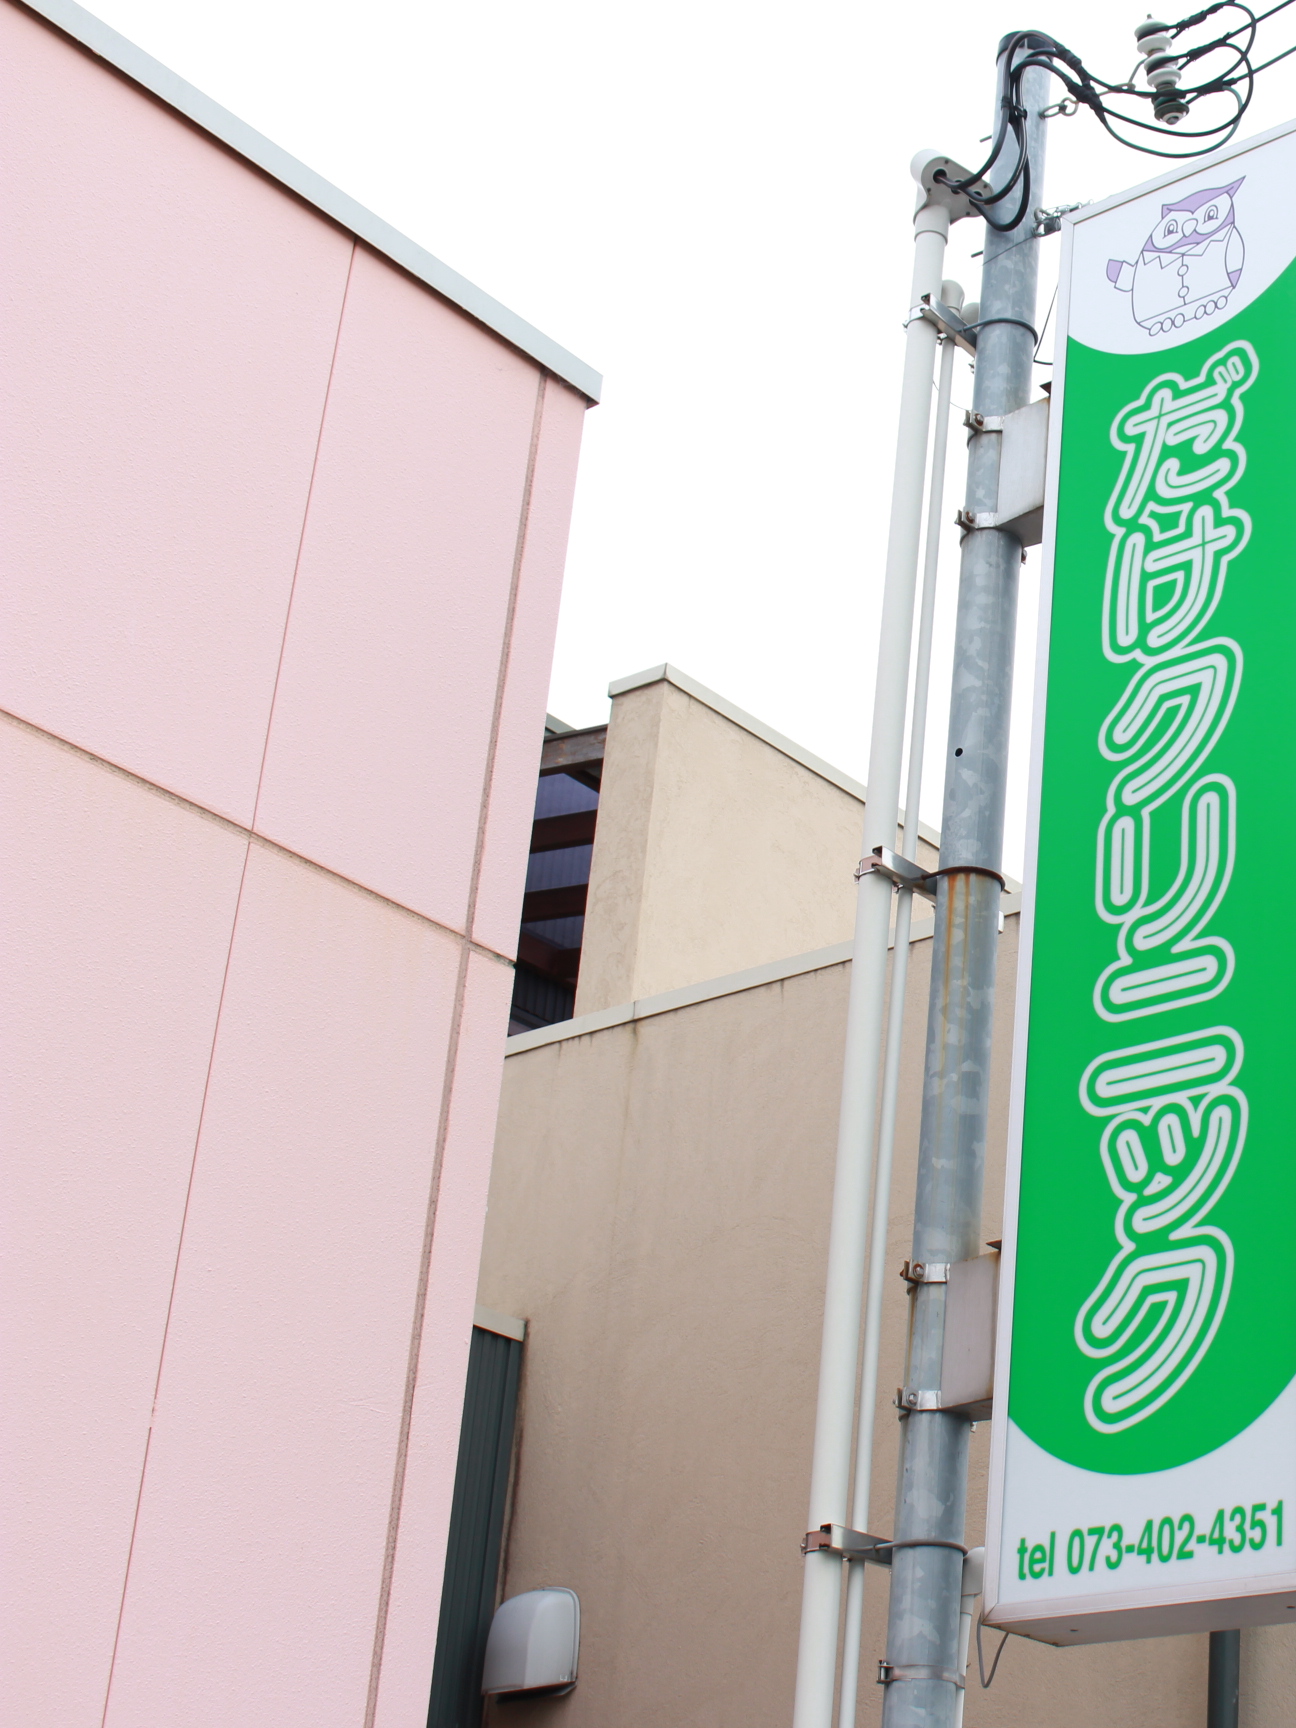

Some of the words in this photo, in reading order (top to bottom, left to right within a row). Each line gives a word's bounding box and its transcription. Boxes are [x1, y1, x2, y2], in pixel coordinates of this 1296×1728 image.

[1076, 339, 1260, 1435] だけクリニック
[1016, 1530, 1057, 1581] tel
[1066, 1499, 1285, 1576] 073-402-4351
